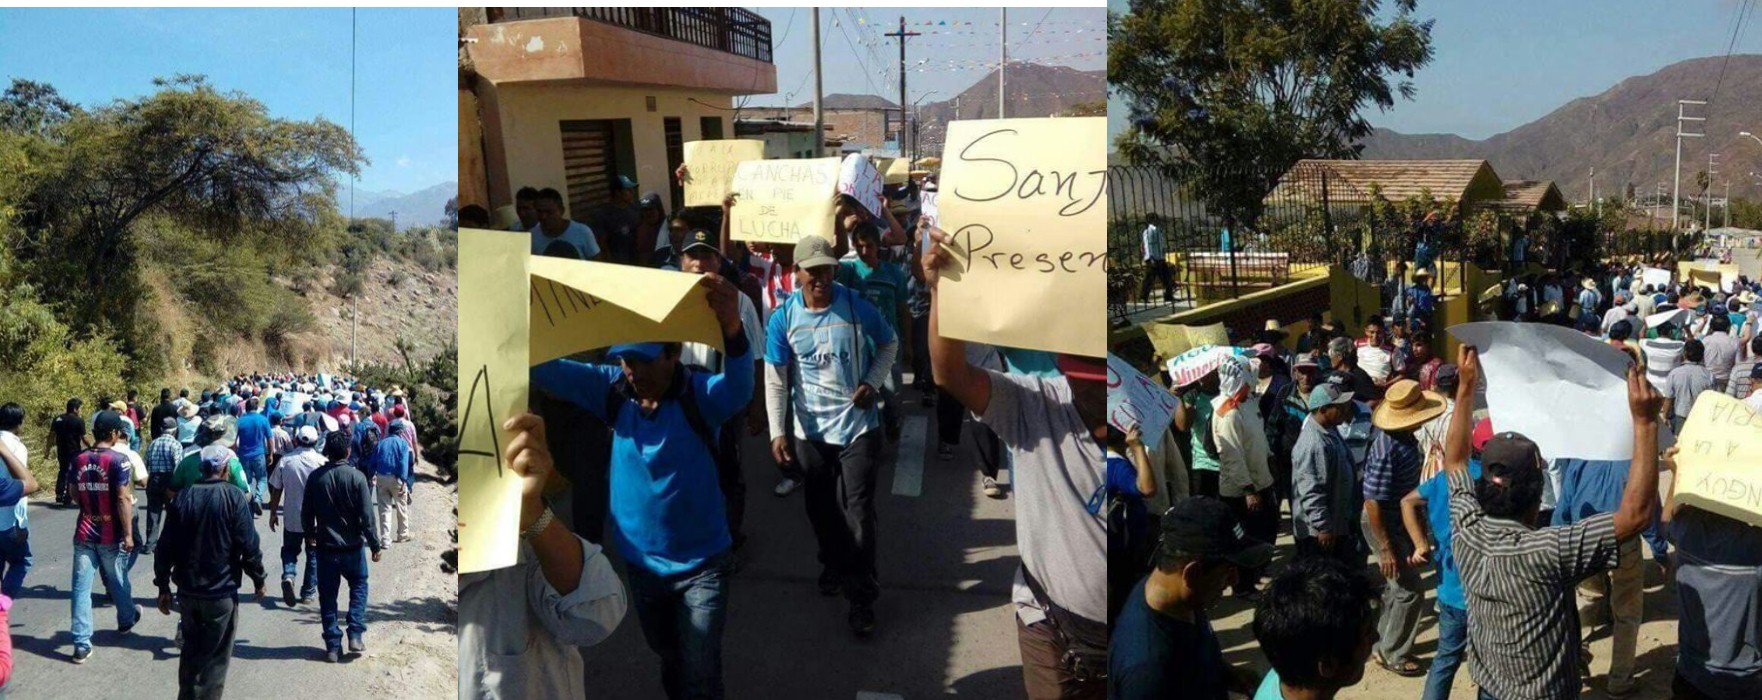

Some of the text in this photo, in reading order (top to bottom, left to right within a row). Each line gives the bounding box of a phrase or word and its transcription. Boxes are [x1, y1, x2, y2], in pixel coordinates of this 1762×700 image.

[739, 164, 828, 185] CANCHAS
[773, 188, 794, 201] PIE
[759, 205, 778, 216] DE
[739, 218, 801, 239] LUCHA
